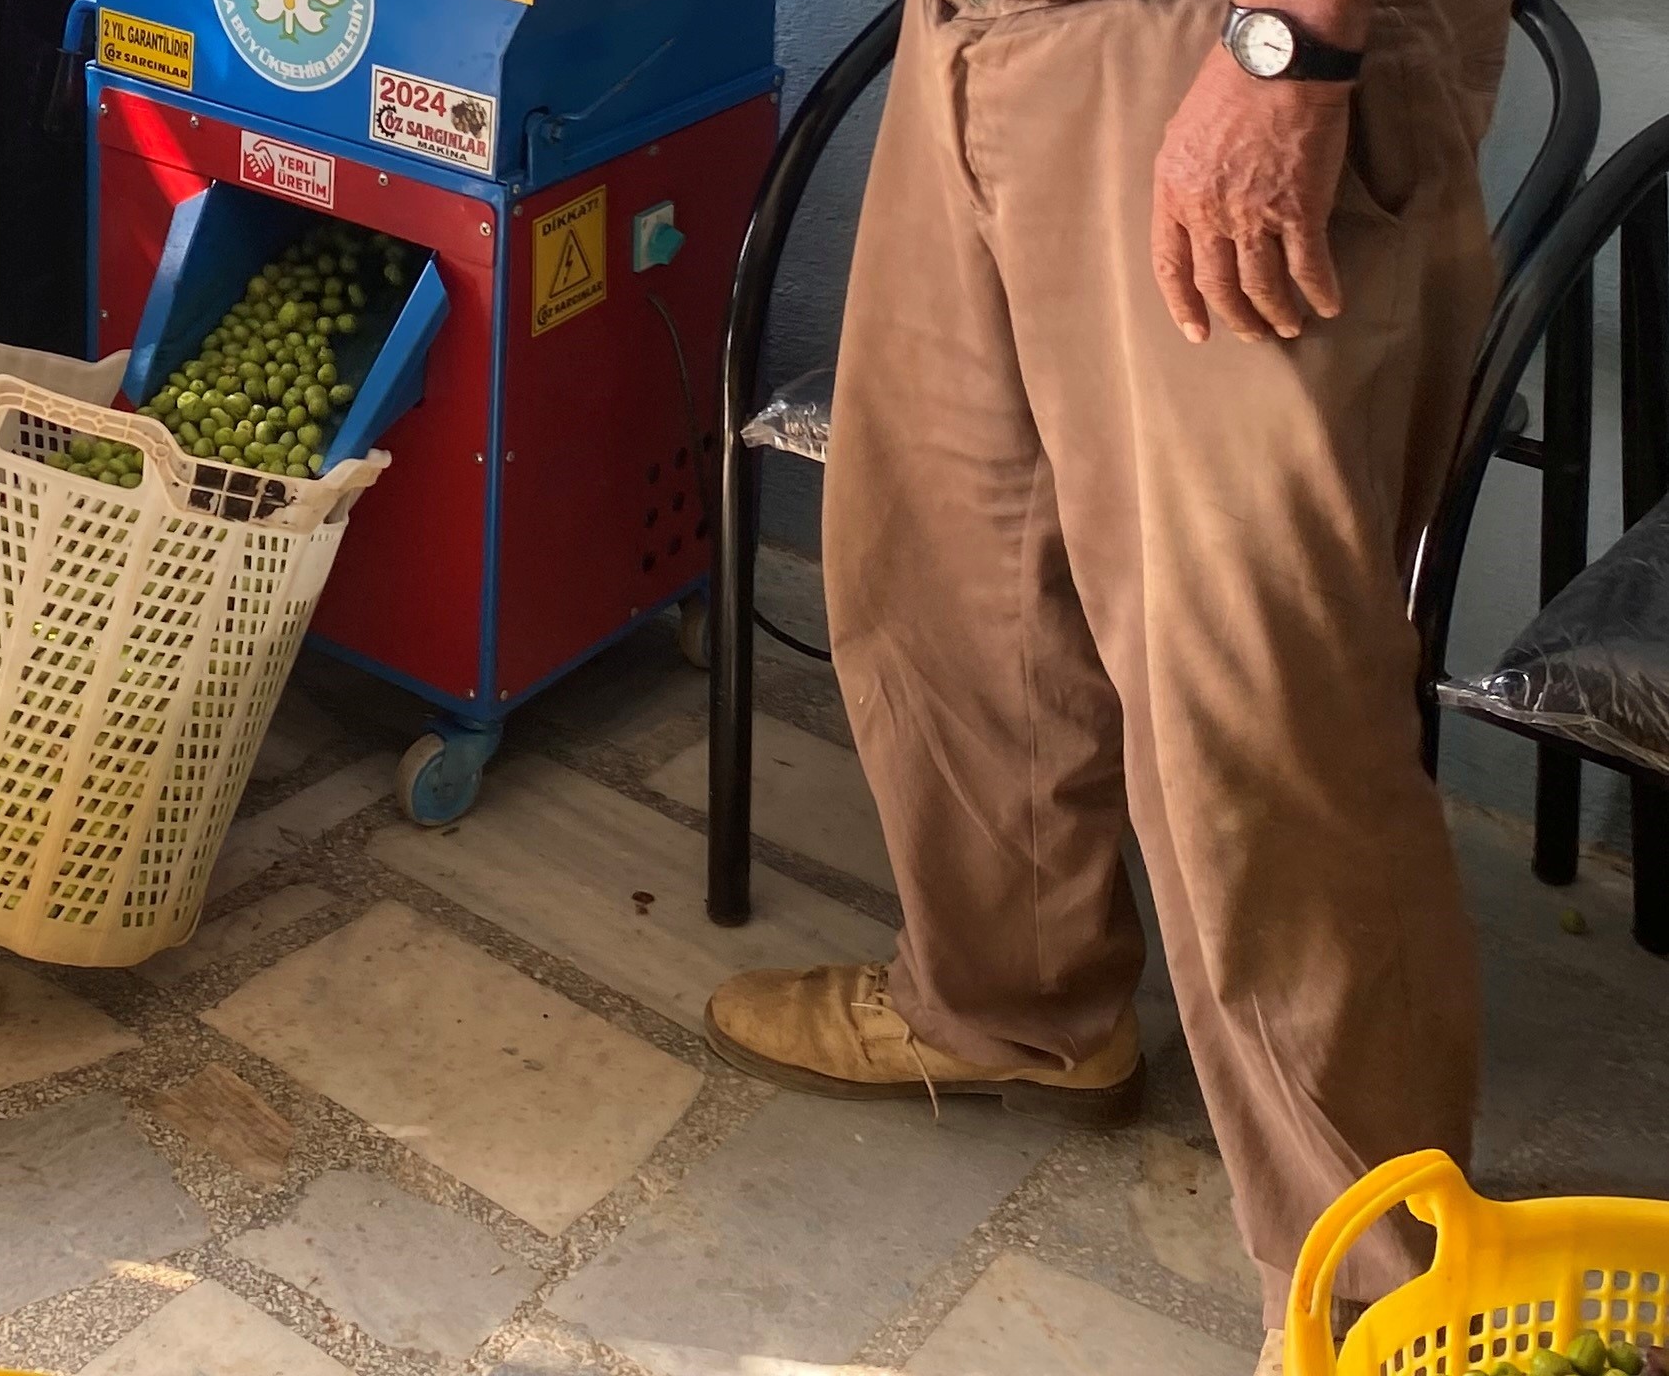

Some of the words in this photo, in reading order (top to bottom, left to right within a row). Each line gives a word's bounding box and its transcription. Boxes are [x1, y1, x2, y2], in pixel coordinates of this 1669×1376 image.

[103, 18, 110, 37] 2
[111, 21, 126, 42] YIL
[127, 25, 189, 61] GARANTİLİDİR
[230, 13, 329, 81] BÜYÜKŞEHİR
[123, 52, 188, 80] SARGINLAR
[379, 75, 447, 118] 2024
[405, 120, 487, 158] SARGINLAR
[417, 140, 468, 162] MAKİNA
[278, 153, 317, 177] YERLİ
[277, 168, 327, 199] ÜRETİM
